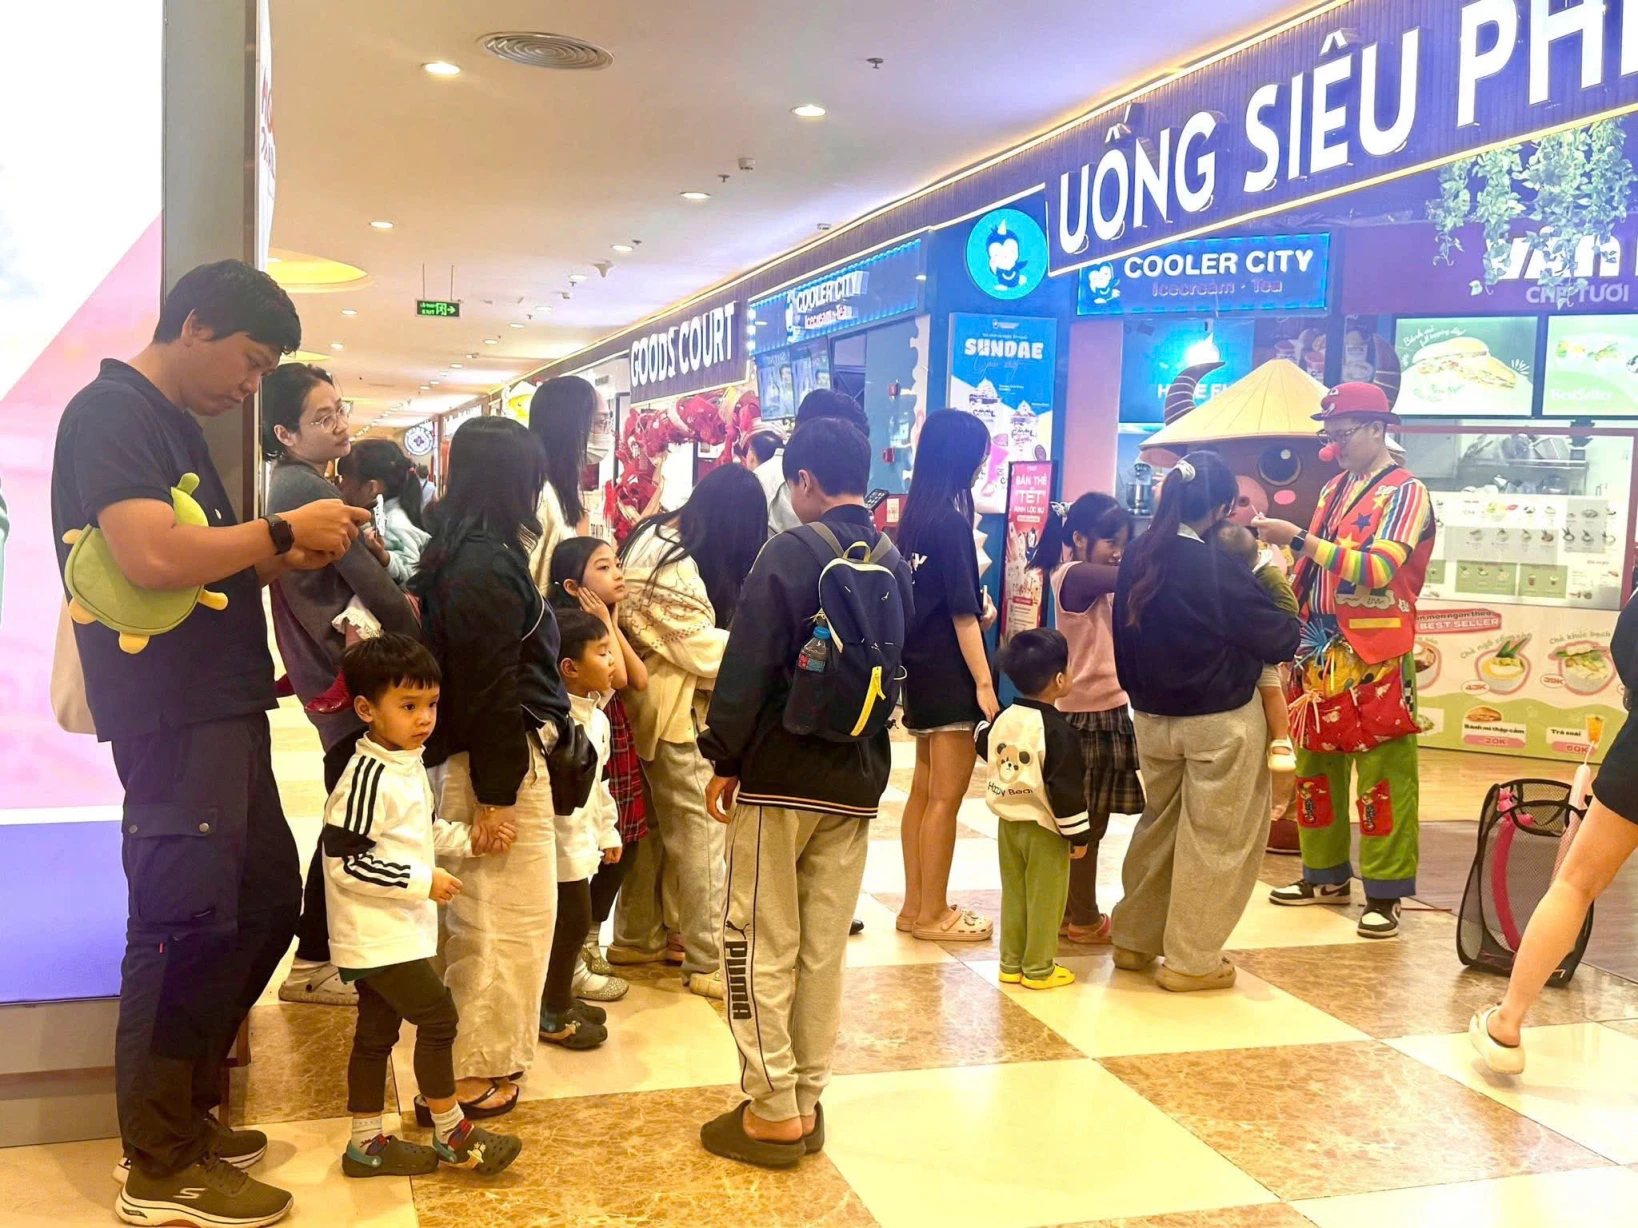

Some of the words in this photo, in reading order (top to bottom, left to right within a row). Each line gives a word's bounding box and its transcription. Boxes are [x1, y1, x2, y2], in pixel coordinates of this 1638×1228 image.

[1059, 104, 1217, 255] UỐNG
[1243, 28, 1419, 193] SIÊU
[1123, 252, 1239, 279] COOLER
[1245, 249, 1314, 274] CITY
[796, 280, 835, 314] COOLER
[835, 270, 863, 301] CITY
[631, 326, 679, 388] GOODS
[678, 301, 736, 376] COURT
[964, 338, 1044, 360] SUNDAE
[1420, 621, 1452, 630] BEST
[1453, 618, 1499, 628] SELLER
